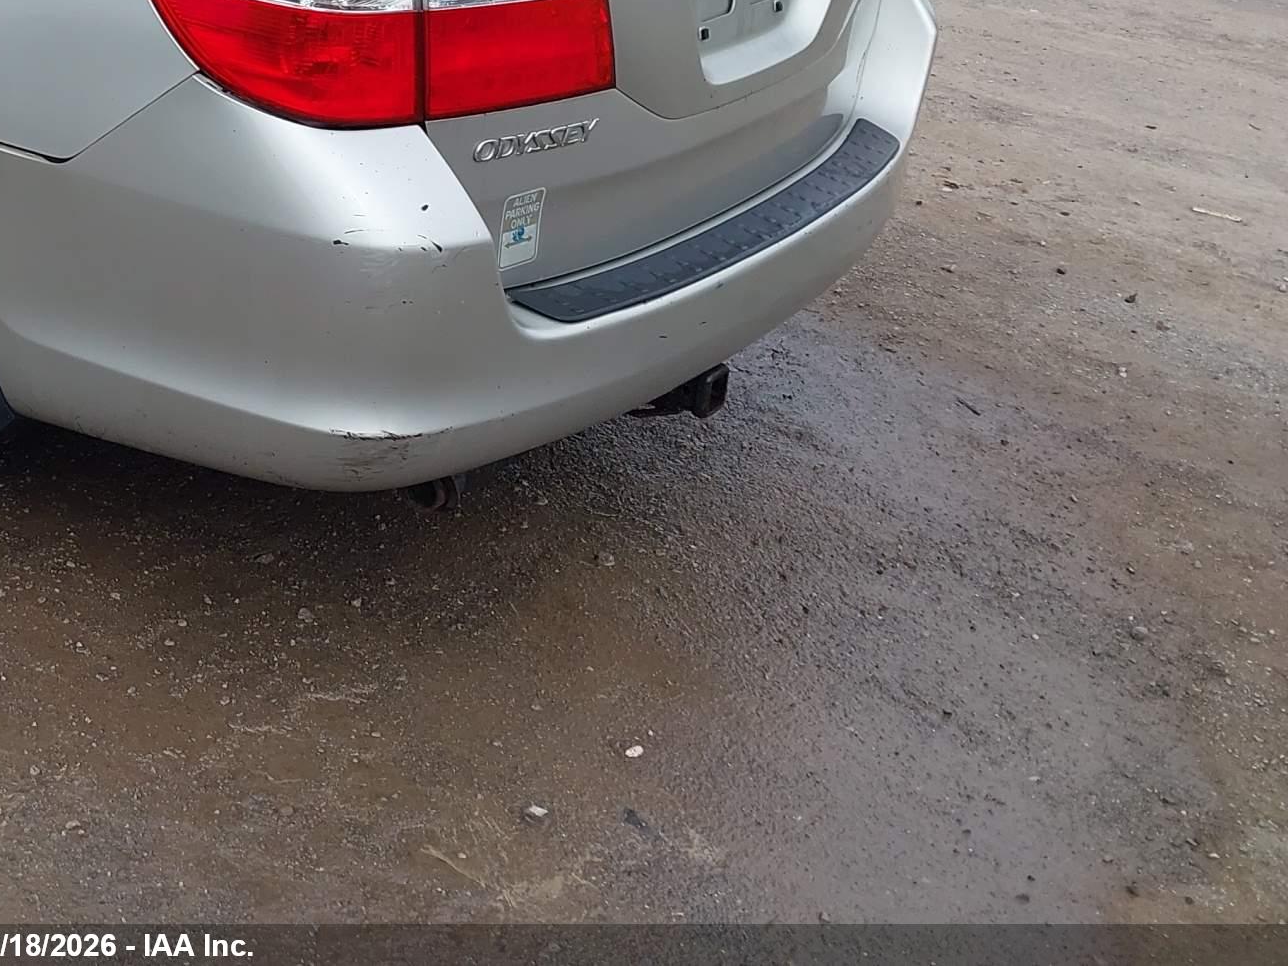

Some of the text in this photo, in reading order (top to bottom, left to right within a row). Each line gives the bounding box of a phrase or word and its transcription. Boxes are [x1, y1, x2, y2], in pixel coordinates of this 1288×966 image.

[473, 117, 600, 163] ODYSSEY
[513, 193, 538, 207] ALIEN
[505, 201, 541, 220] PARKING
[510, 214, 532, 229] ONLY
